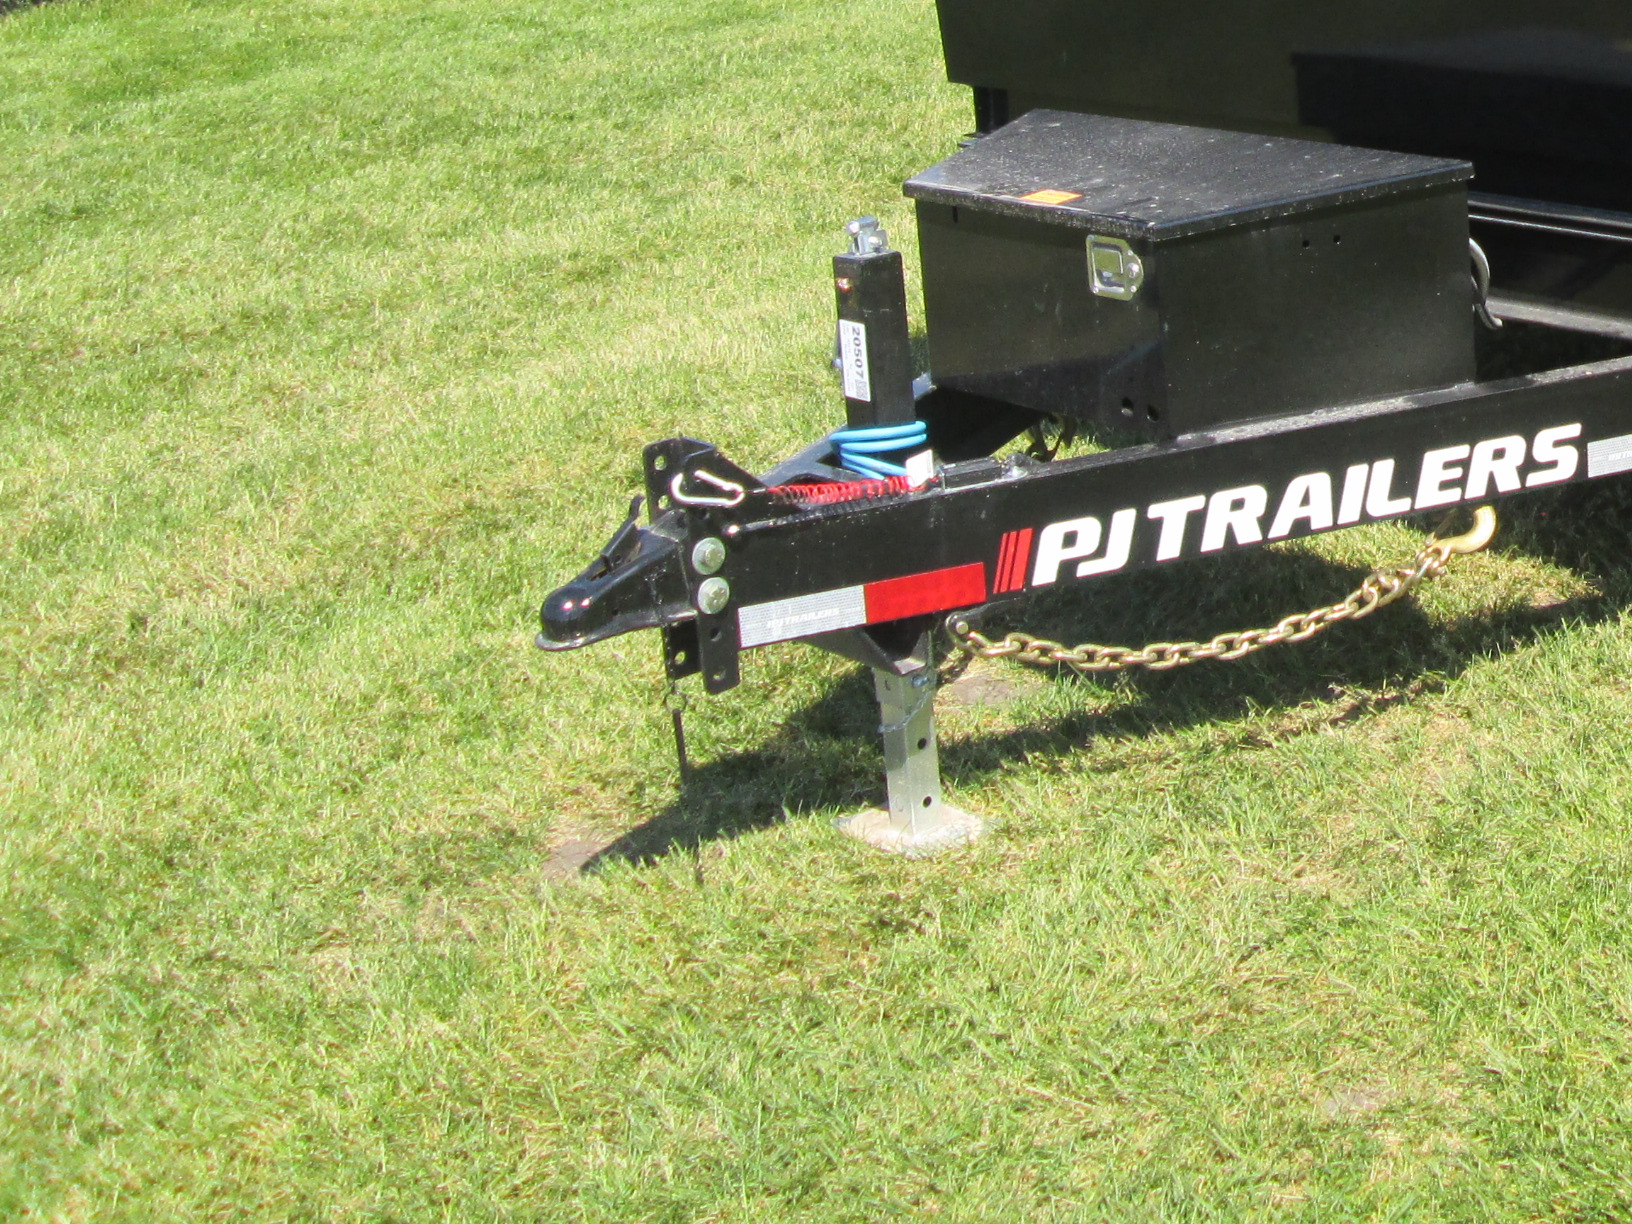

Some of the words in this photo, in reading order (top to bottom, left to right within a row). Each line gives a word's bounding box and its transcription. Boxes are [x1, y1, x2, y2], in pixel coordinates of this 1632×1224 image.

[851, 327, 866, 379] 20507
[1031, 508, 1137, 587] PJ
[1147, 422, 1583, 562] TRAILERS
